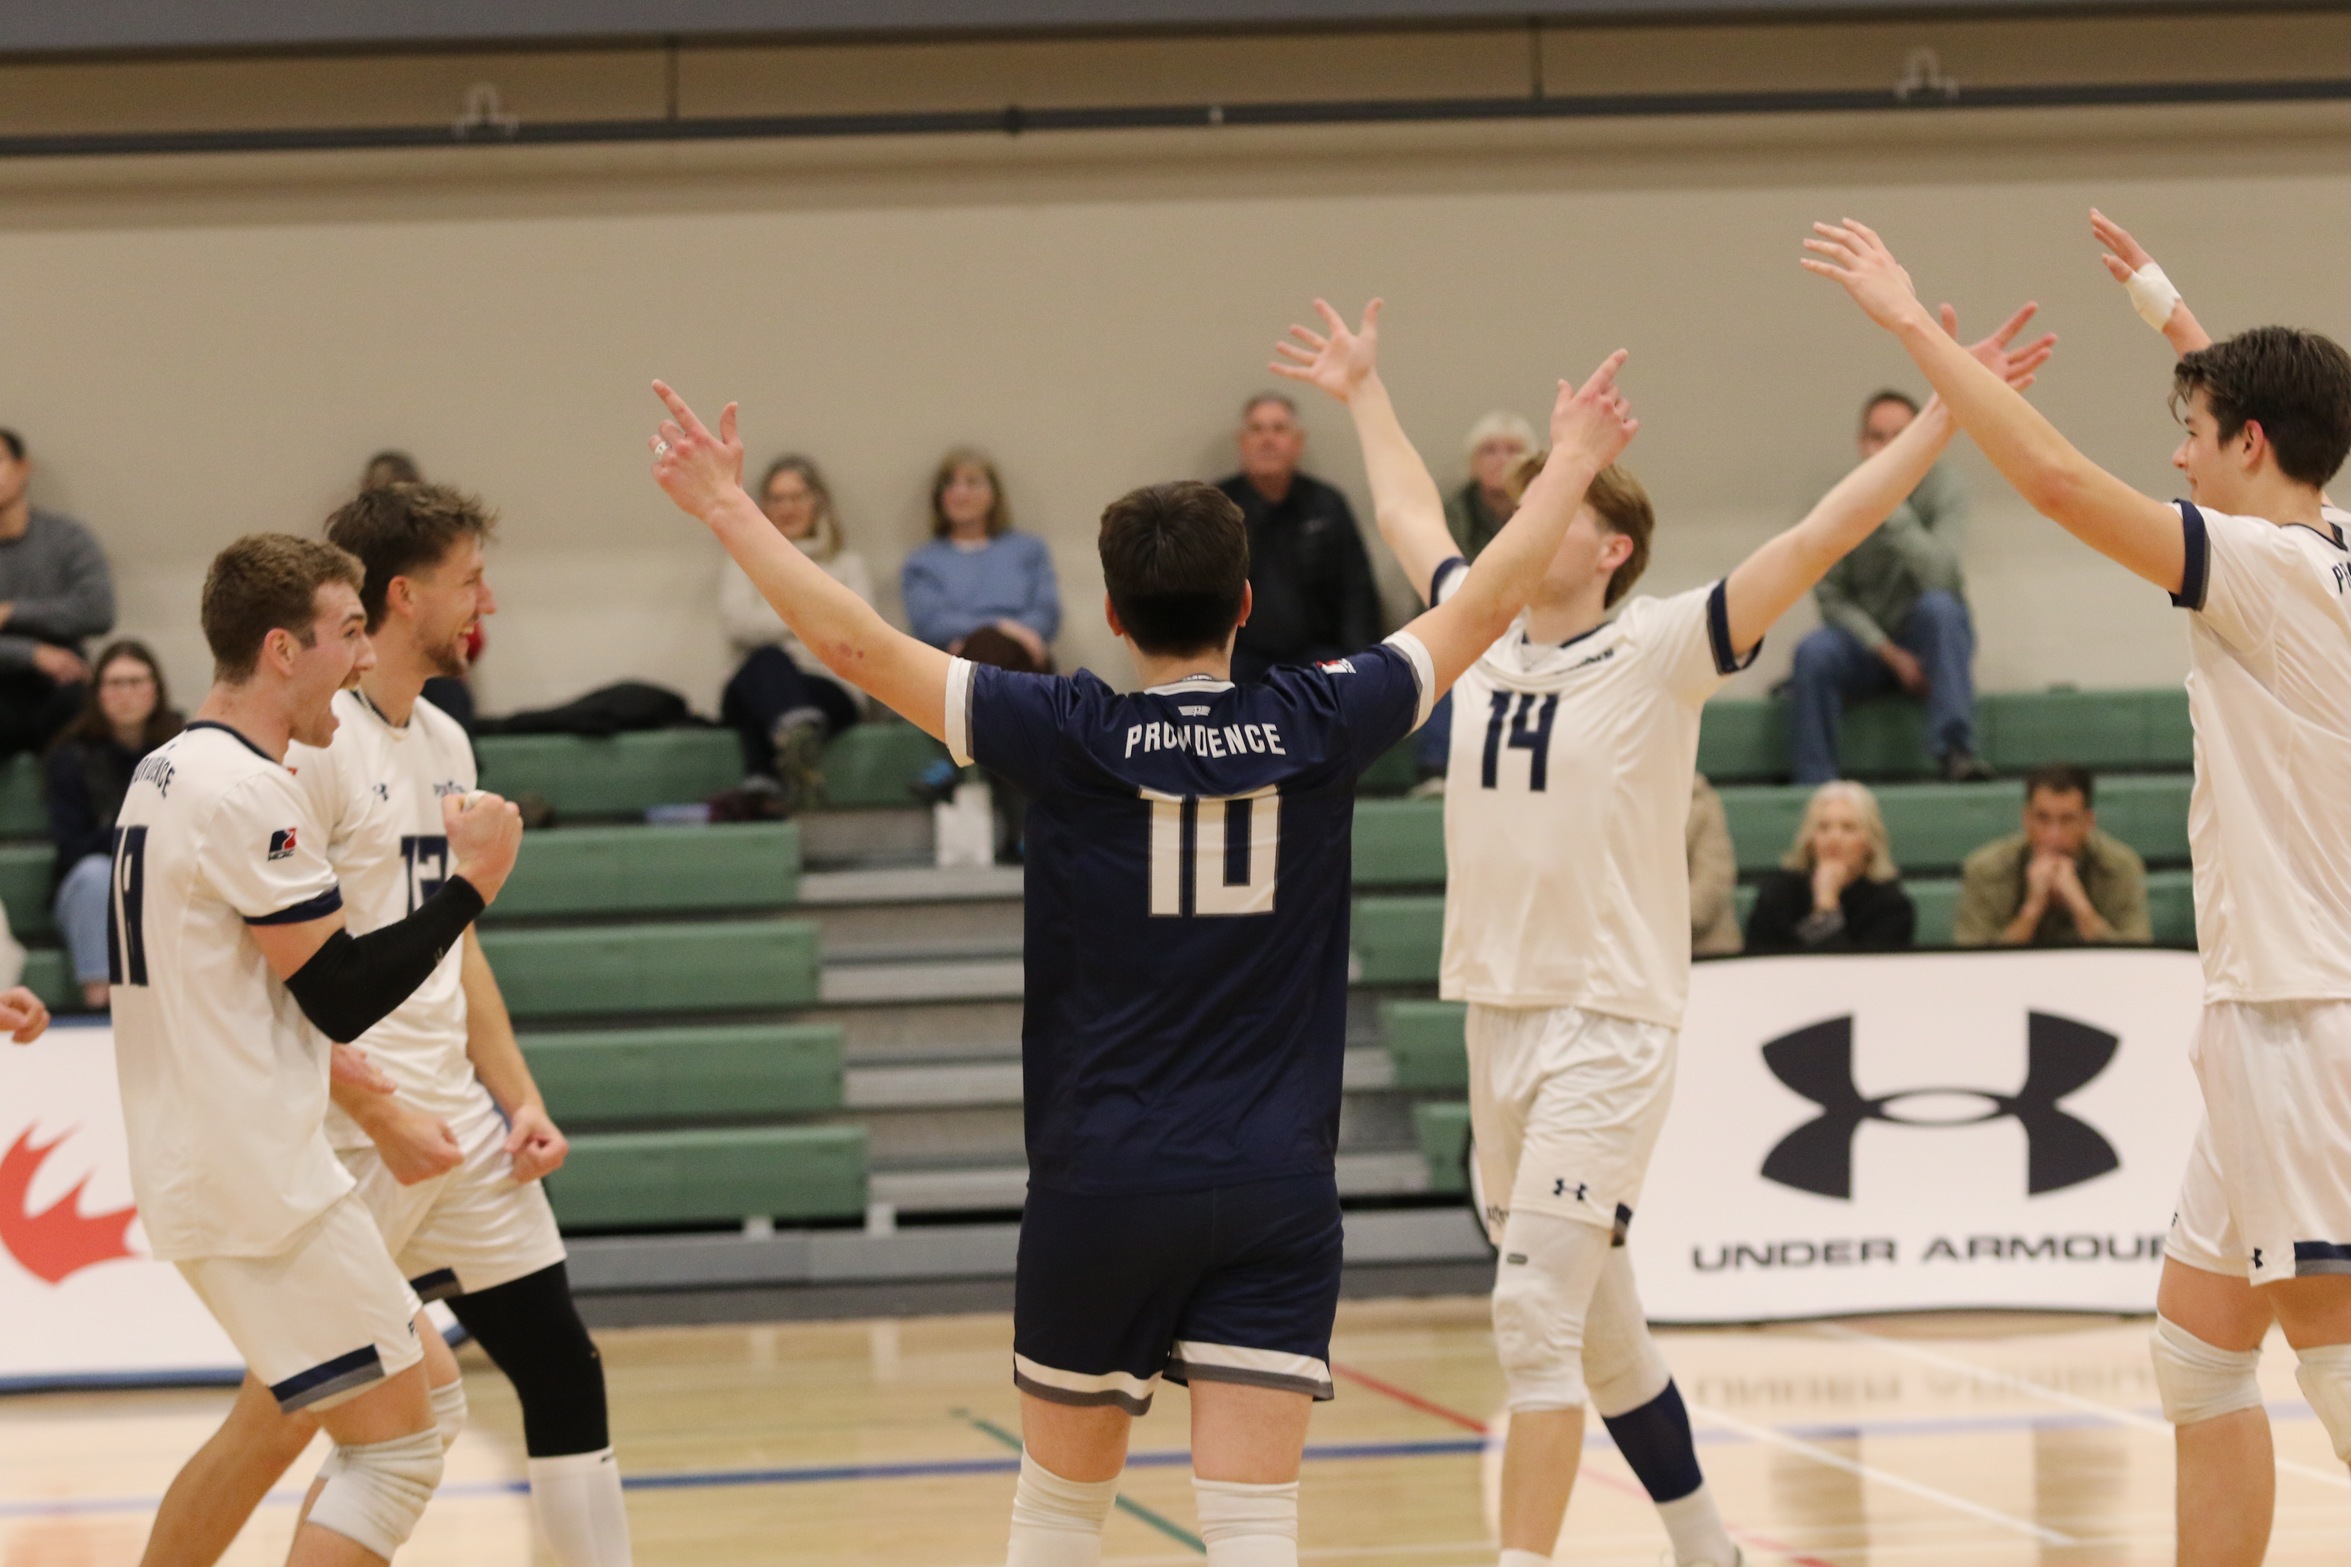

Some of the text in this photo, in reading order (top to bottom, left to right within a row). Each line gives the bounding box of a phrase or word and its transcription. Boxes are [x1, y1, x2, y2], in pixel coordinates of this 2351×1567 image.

[1125, 721, 1286, 759] PROVIDENCE
[1481, 690, 1559, 793] 14
[1139, 784, 1281, 918] 10
[1693, 1237, 1896, 1273] UNDER
